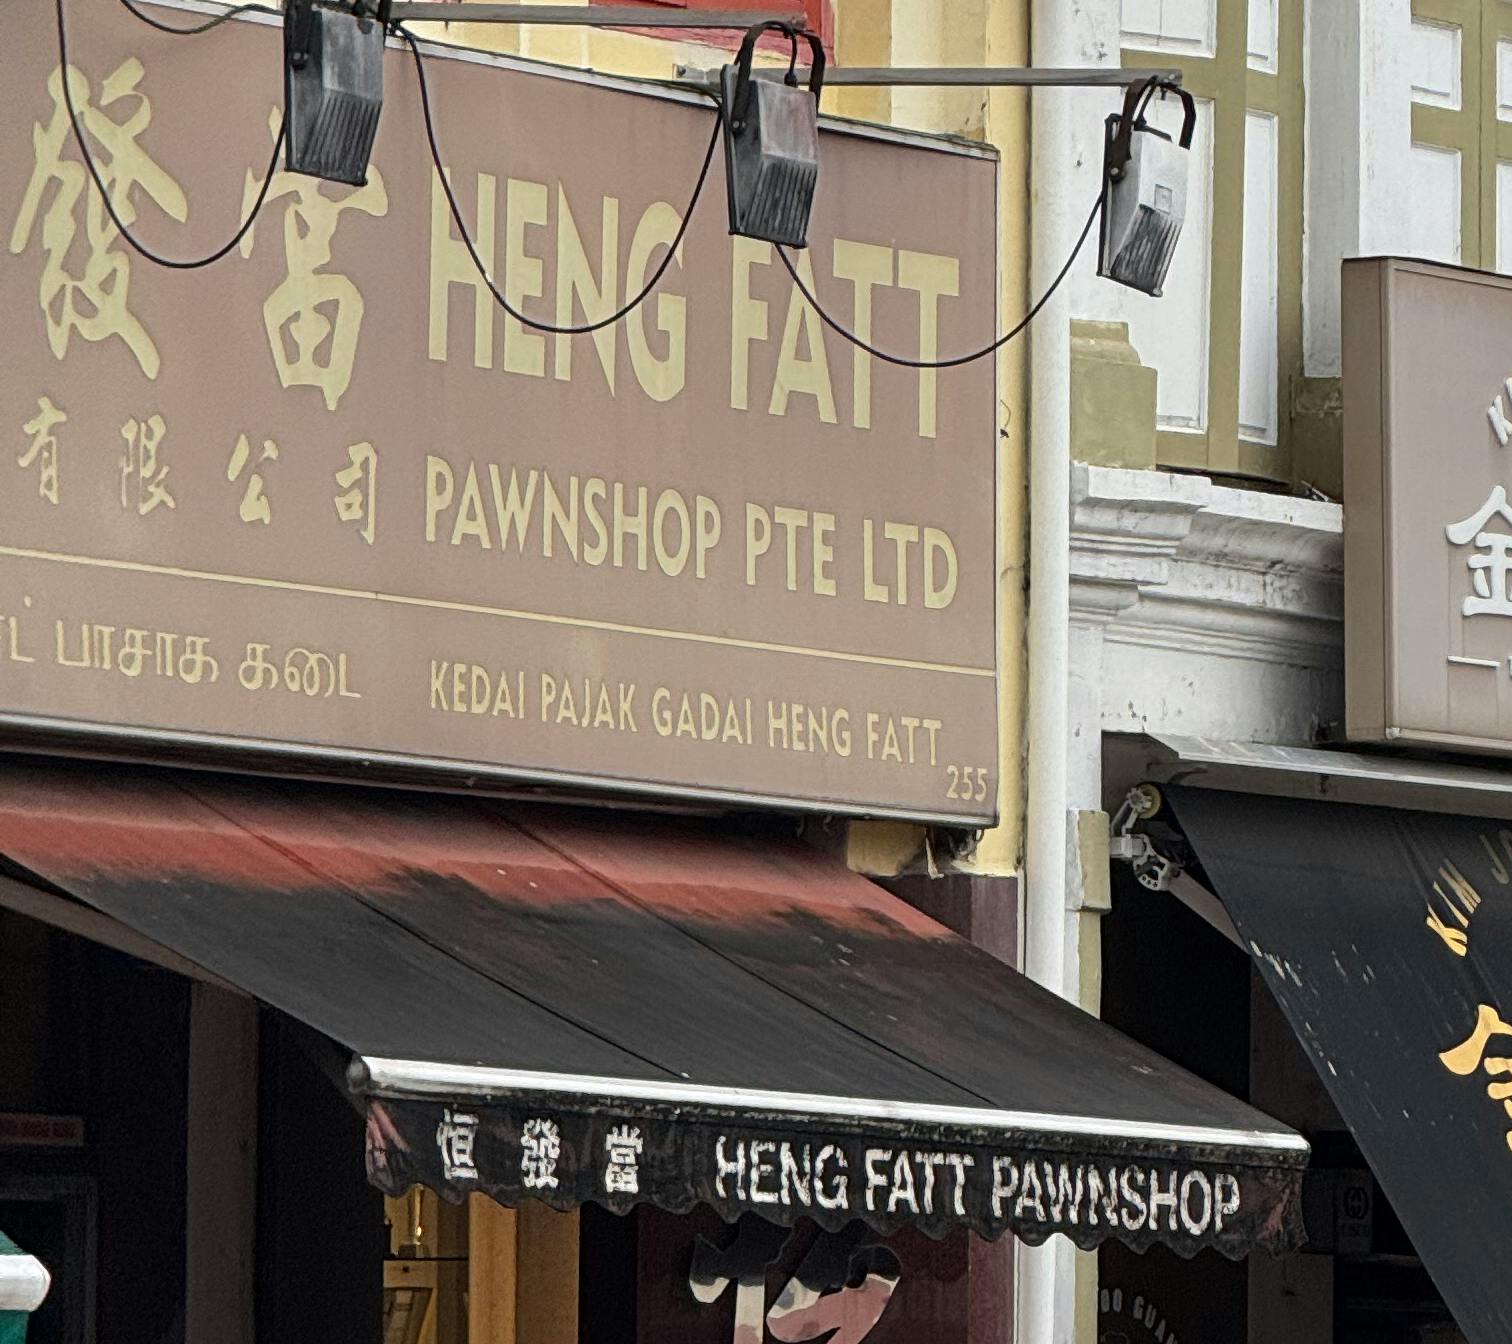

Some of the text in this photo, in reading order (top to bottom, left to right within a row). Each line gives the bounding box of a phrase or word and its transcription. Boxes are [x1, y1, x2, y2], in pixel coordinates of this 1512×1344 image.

[428, 164, 960, 439] HENG FATT
[18, 397, 378, 545] 有限公司
[425, 454, 959, 610] PAWNSHOP PTE LTD
[429, 659, 943, 767] KEDAI PAJAK GADAI HENG FATT
[946, 764, 989, 803] 255
[1425, 857, 1482, 958] KIM
[714, 1134, 1241, 1235] HENG FATT PAWNSHOP
